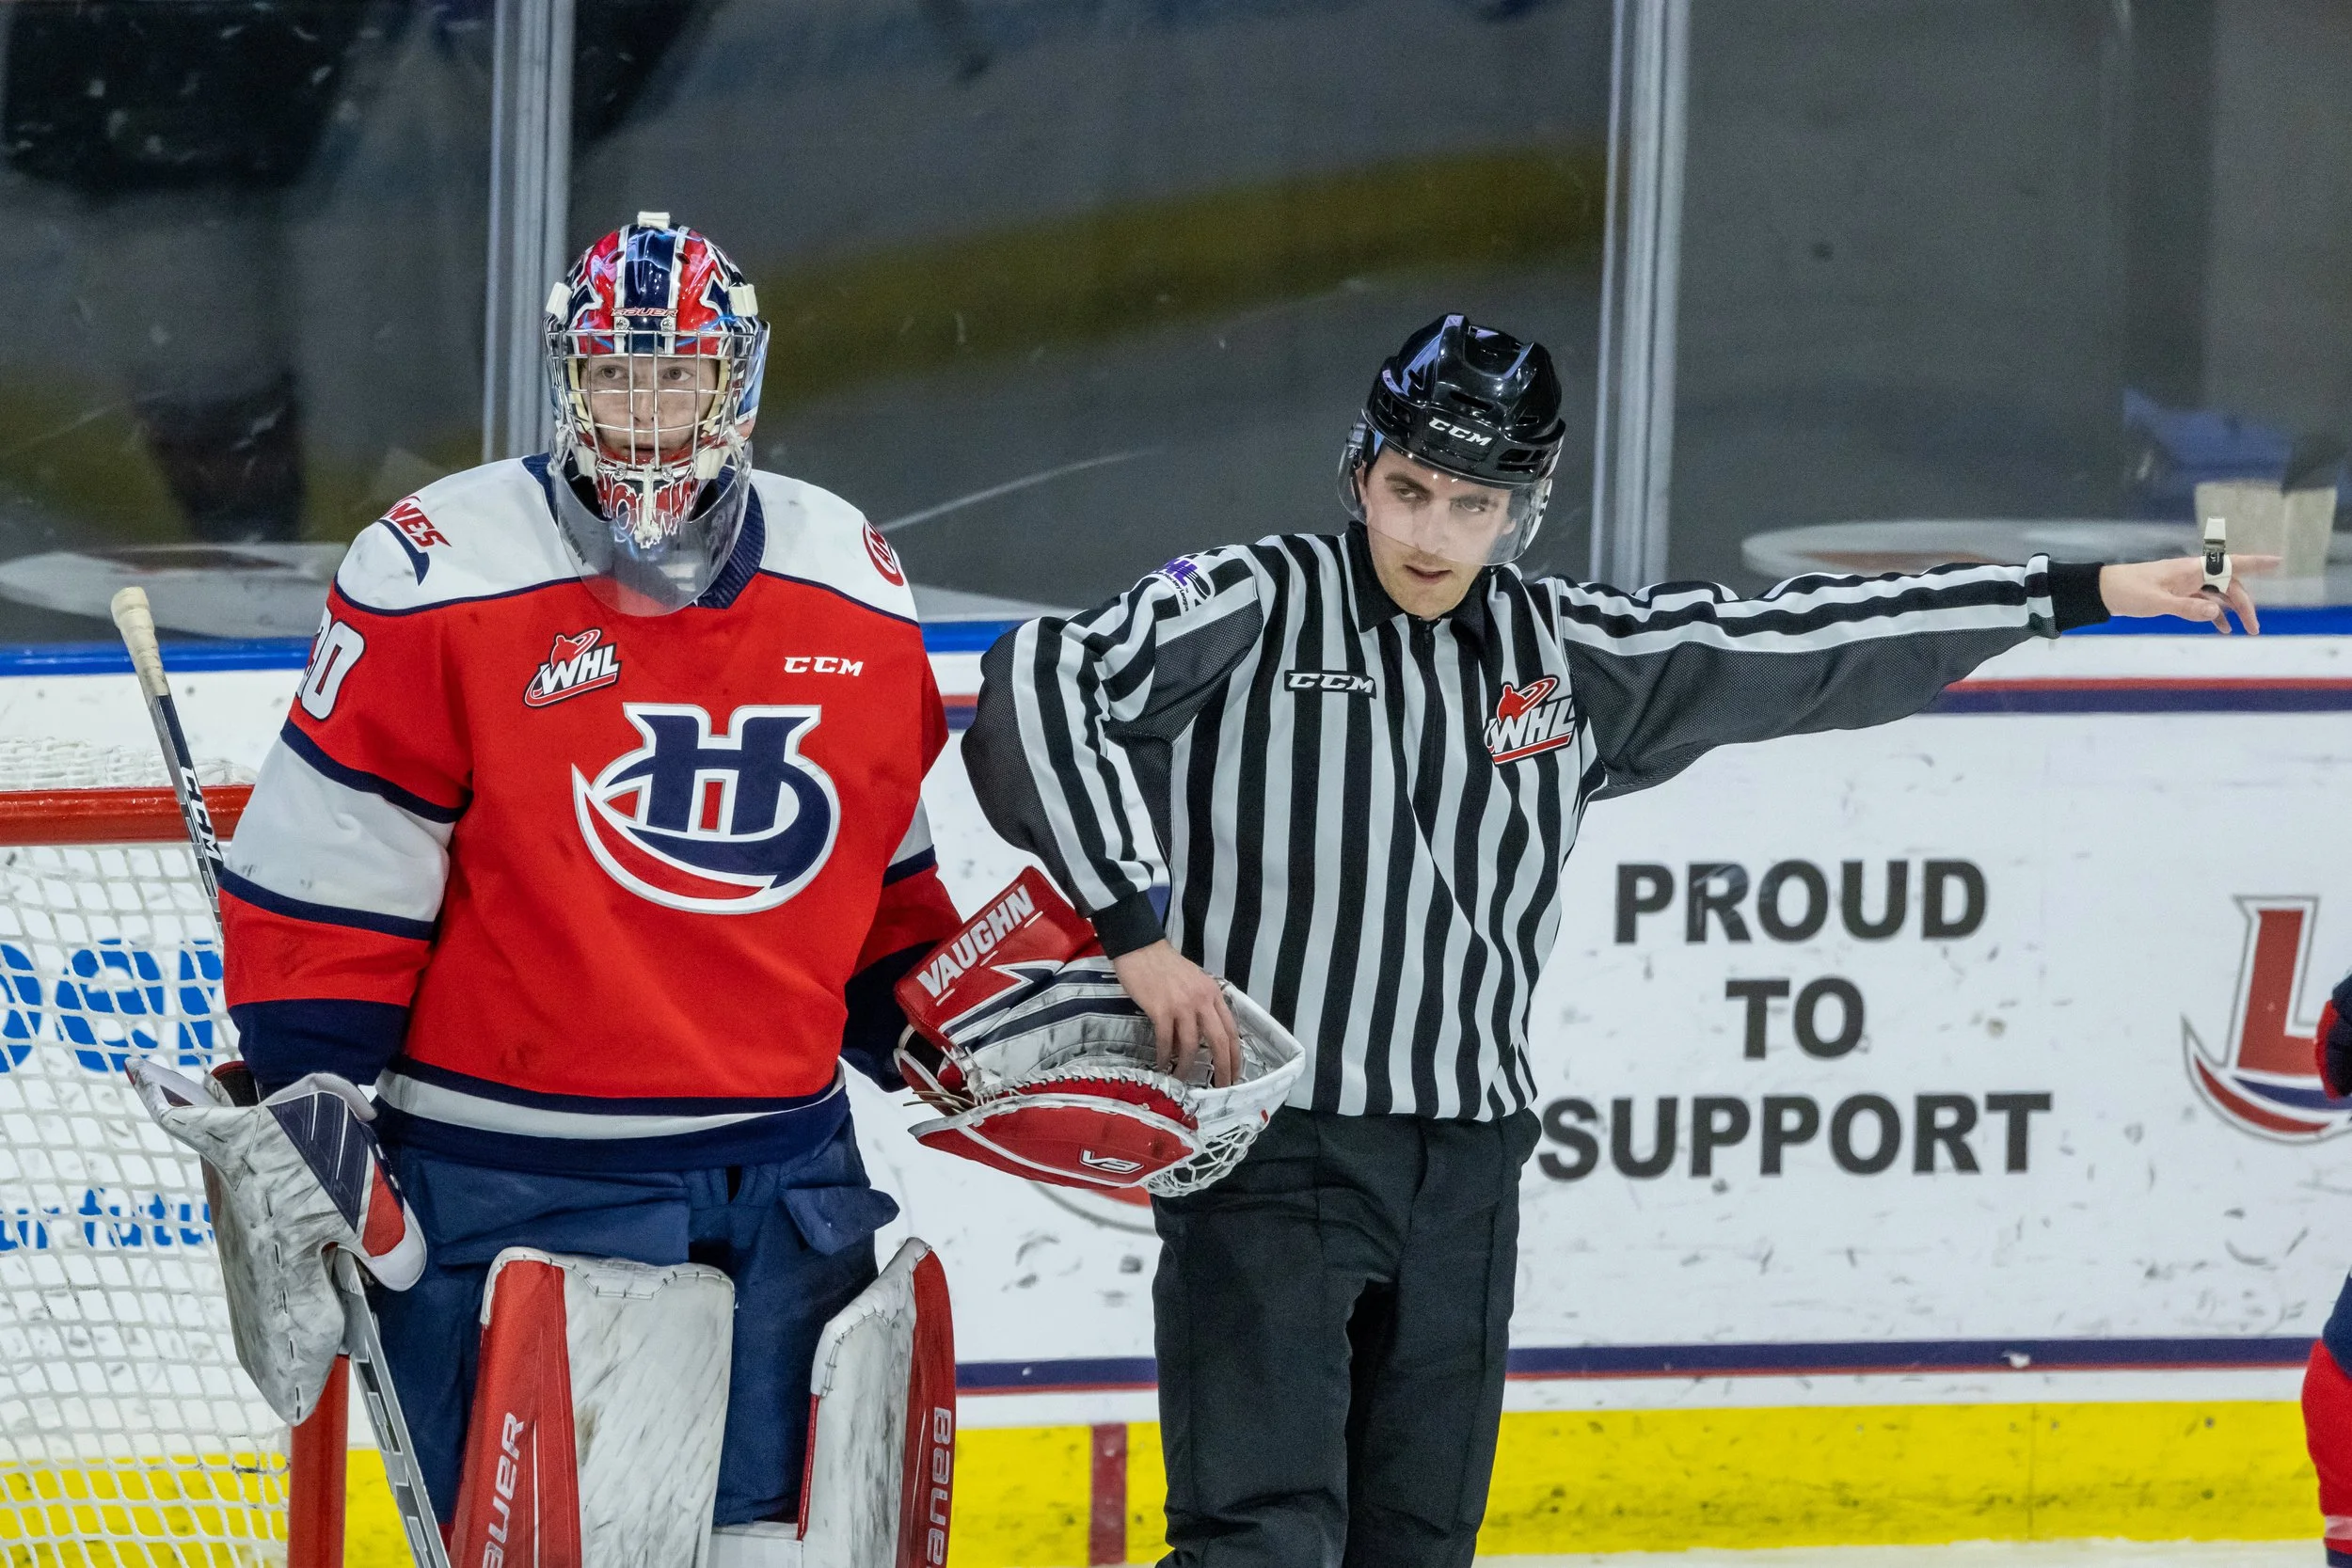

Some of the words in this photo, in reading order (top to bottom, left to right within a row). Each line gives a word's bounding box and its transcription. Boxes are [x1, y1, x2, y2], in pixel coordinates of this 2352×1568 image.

[1429, 417, 1492, 446] CCM
[388, 500, 452, 547] NES
[540, 644, 619, 695] WHL
[784, 656, 864, 677] CCM
[1288, 673, 1375, 693] CCM
[1487, 697, 1576, 753] WHL
[1614, 859, 1988, 943] PROUD
[915, 883, 1036, 999] VAUGHN
[1725, 976, 1866, 1059] TO
[1537, 1092, 2054, 1181] SUPPORT
[926, 1406, 952, 1568] BAUE
